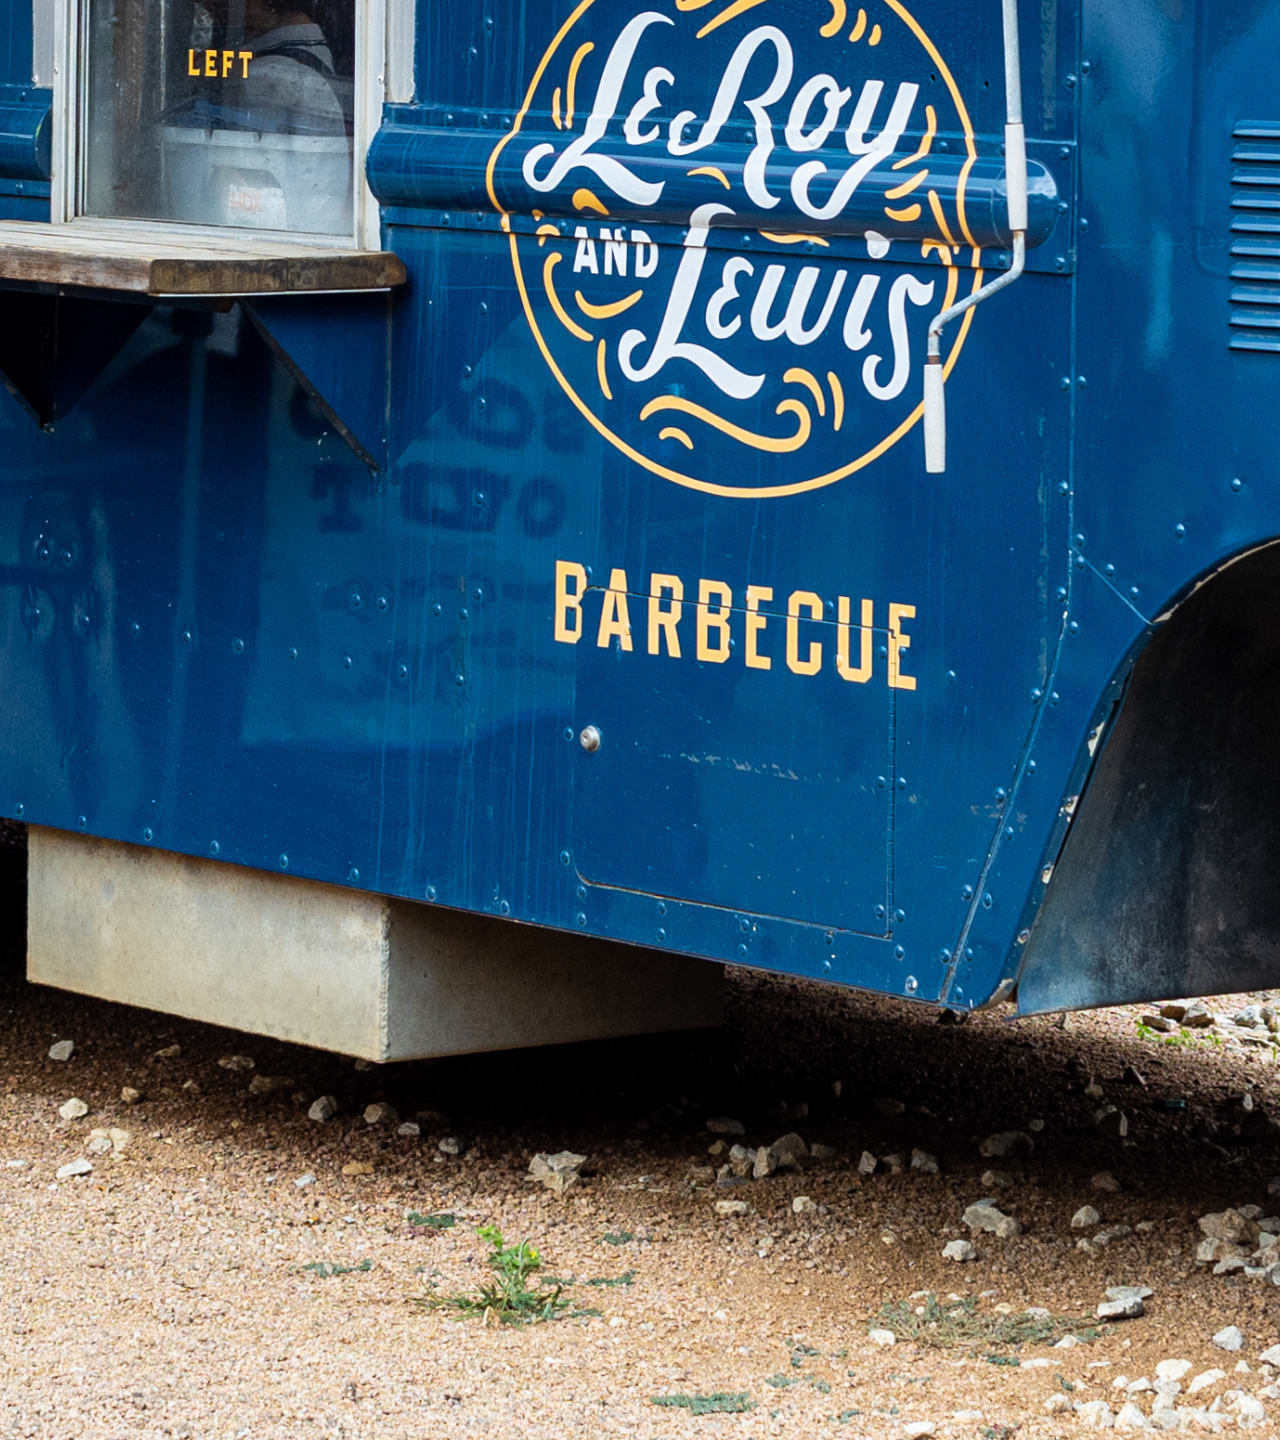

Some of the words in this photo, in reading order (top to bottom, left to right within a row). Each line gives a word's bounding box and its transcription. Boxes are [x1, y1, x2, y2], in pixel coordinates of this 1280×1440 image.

[187, 48, 253, 79] LEFT
[573, 225, 660, 279] AND
[617, 203, 935, 401] Lewis
[553, 560, 917, 691] BARBECUE
